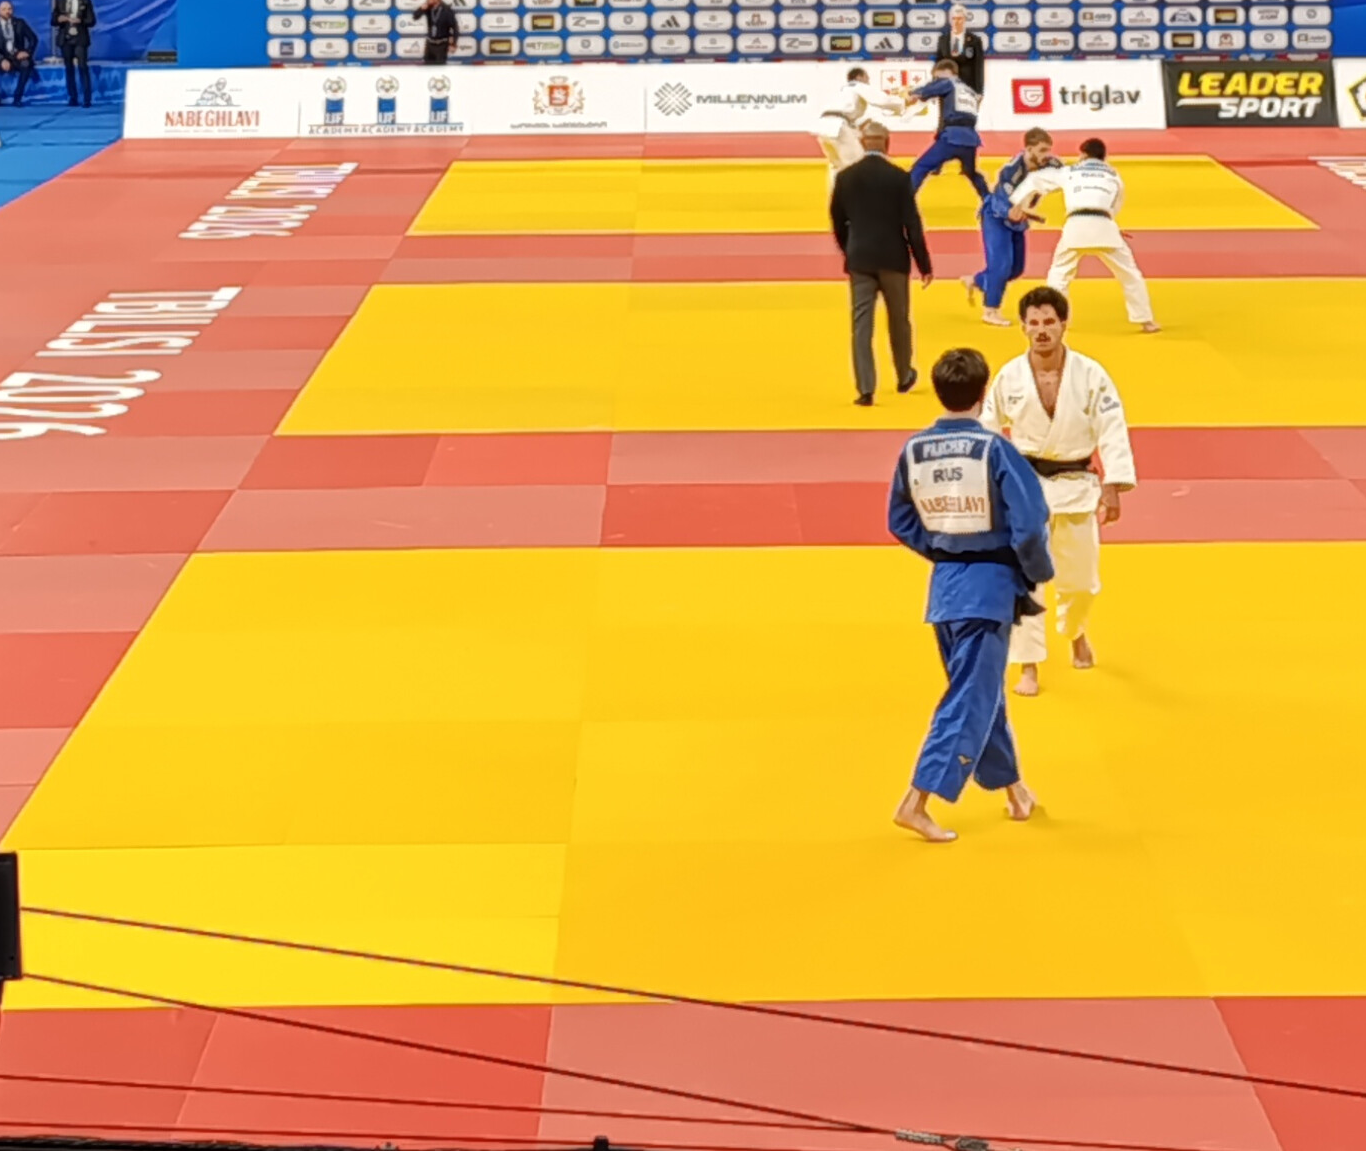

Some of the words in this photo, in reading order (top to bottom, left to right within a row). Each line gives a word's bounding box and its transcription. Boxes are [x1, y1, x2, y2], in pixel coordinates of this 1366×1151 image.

[1177, 70, 1324, 97] LEADER
[696, 93, 807, 106] MILLENNIUM
[1059, 84, 1141, 111] triglav
[1218, 96, 1322, 119] SPORT
[164, 108, 260, 128] NABEGHLAVI
[308, 126, 360, 135] ACADEMY
[361, 125, 412, 134] ACADEMY
[413, 124, 464, 134] ACADEMY
[35, 285, 243, 357] TBILISI
[932, 466, 964, 484] RUS
